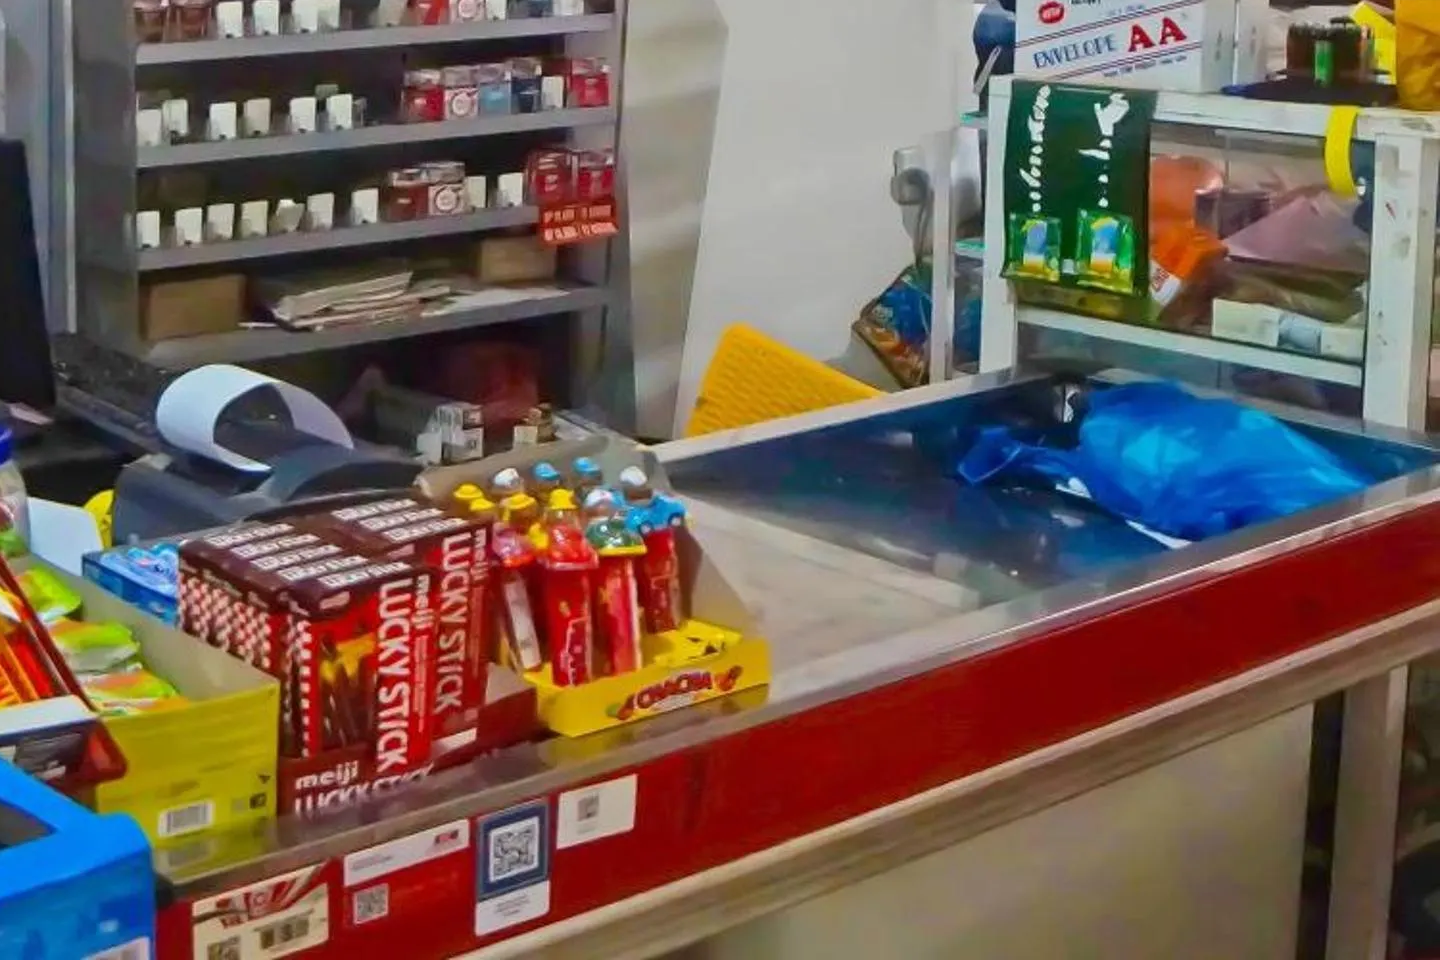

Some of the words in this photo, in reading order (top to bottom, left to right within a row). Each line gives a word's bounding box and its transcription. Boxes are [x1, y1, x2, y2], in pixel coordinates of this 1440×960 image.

[1033, 34, 1116, 69] ENVELOPE
[1128, 16, 1188, 53] AA
[440, 532, 472, 624] LUCKY
[377, 578, 414, 677] LUCKY
[434, 634, 466, 715] STICK
[375, 681, 411, 773] STICK
[295, 760, 358, 790] meiji
